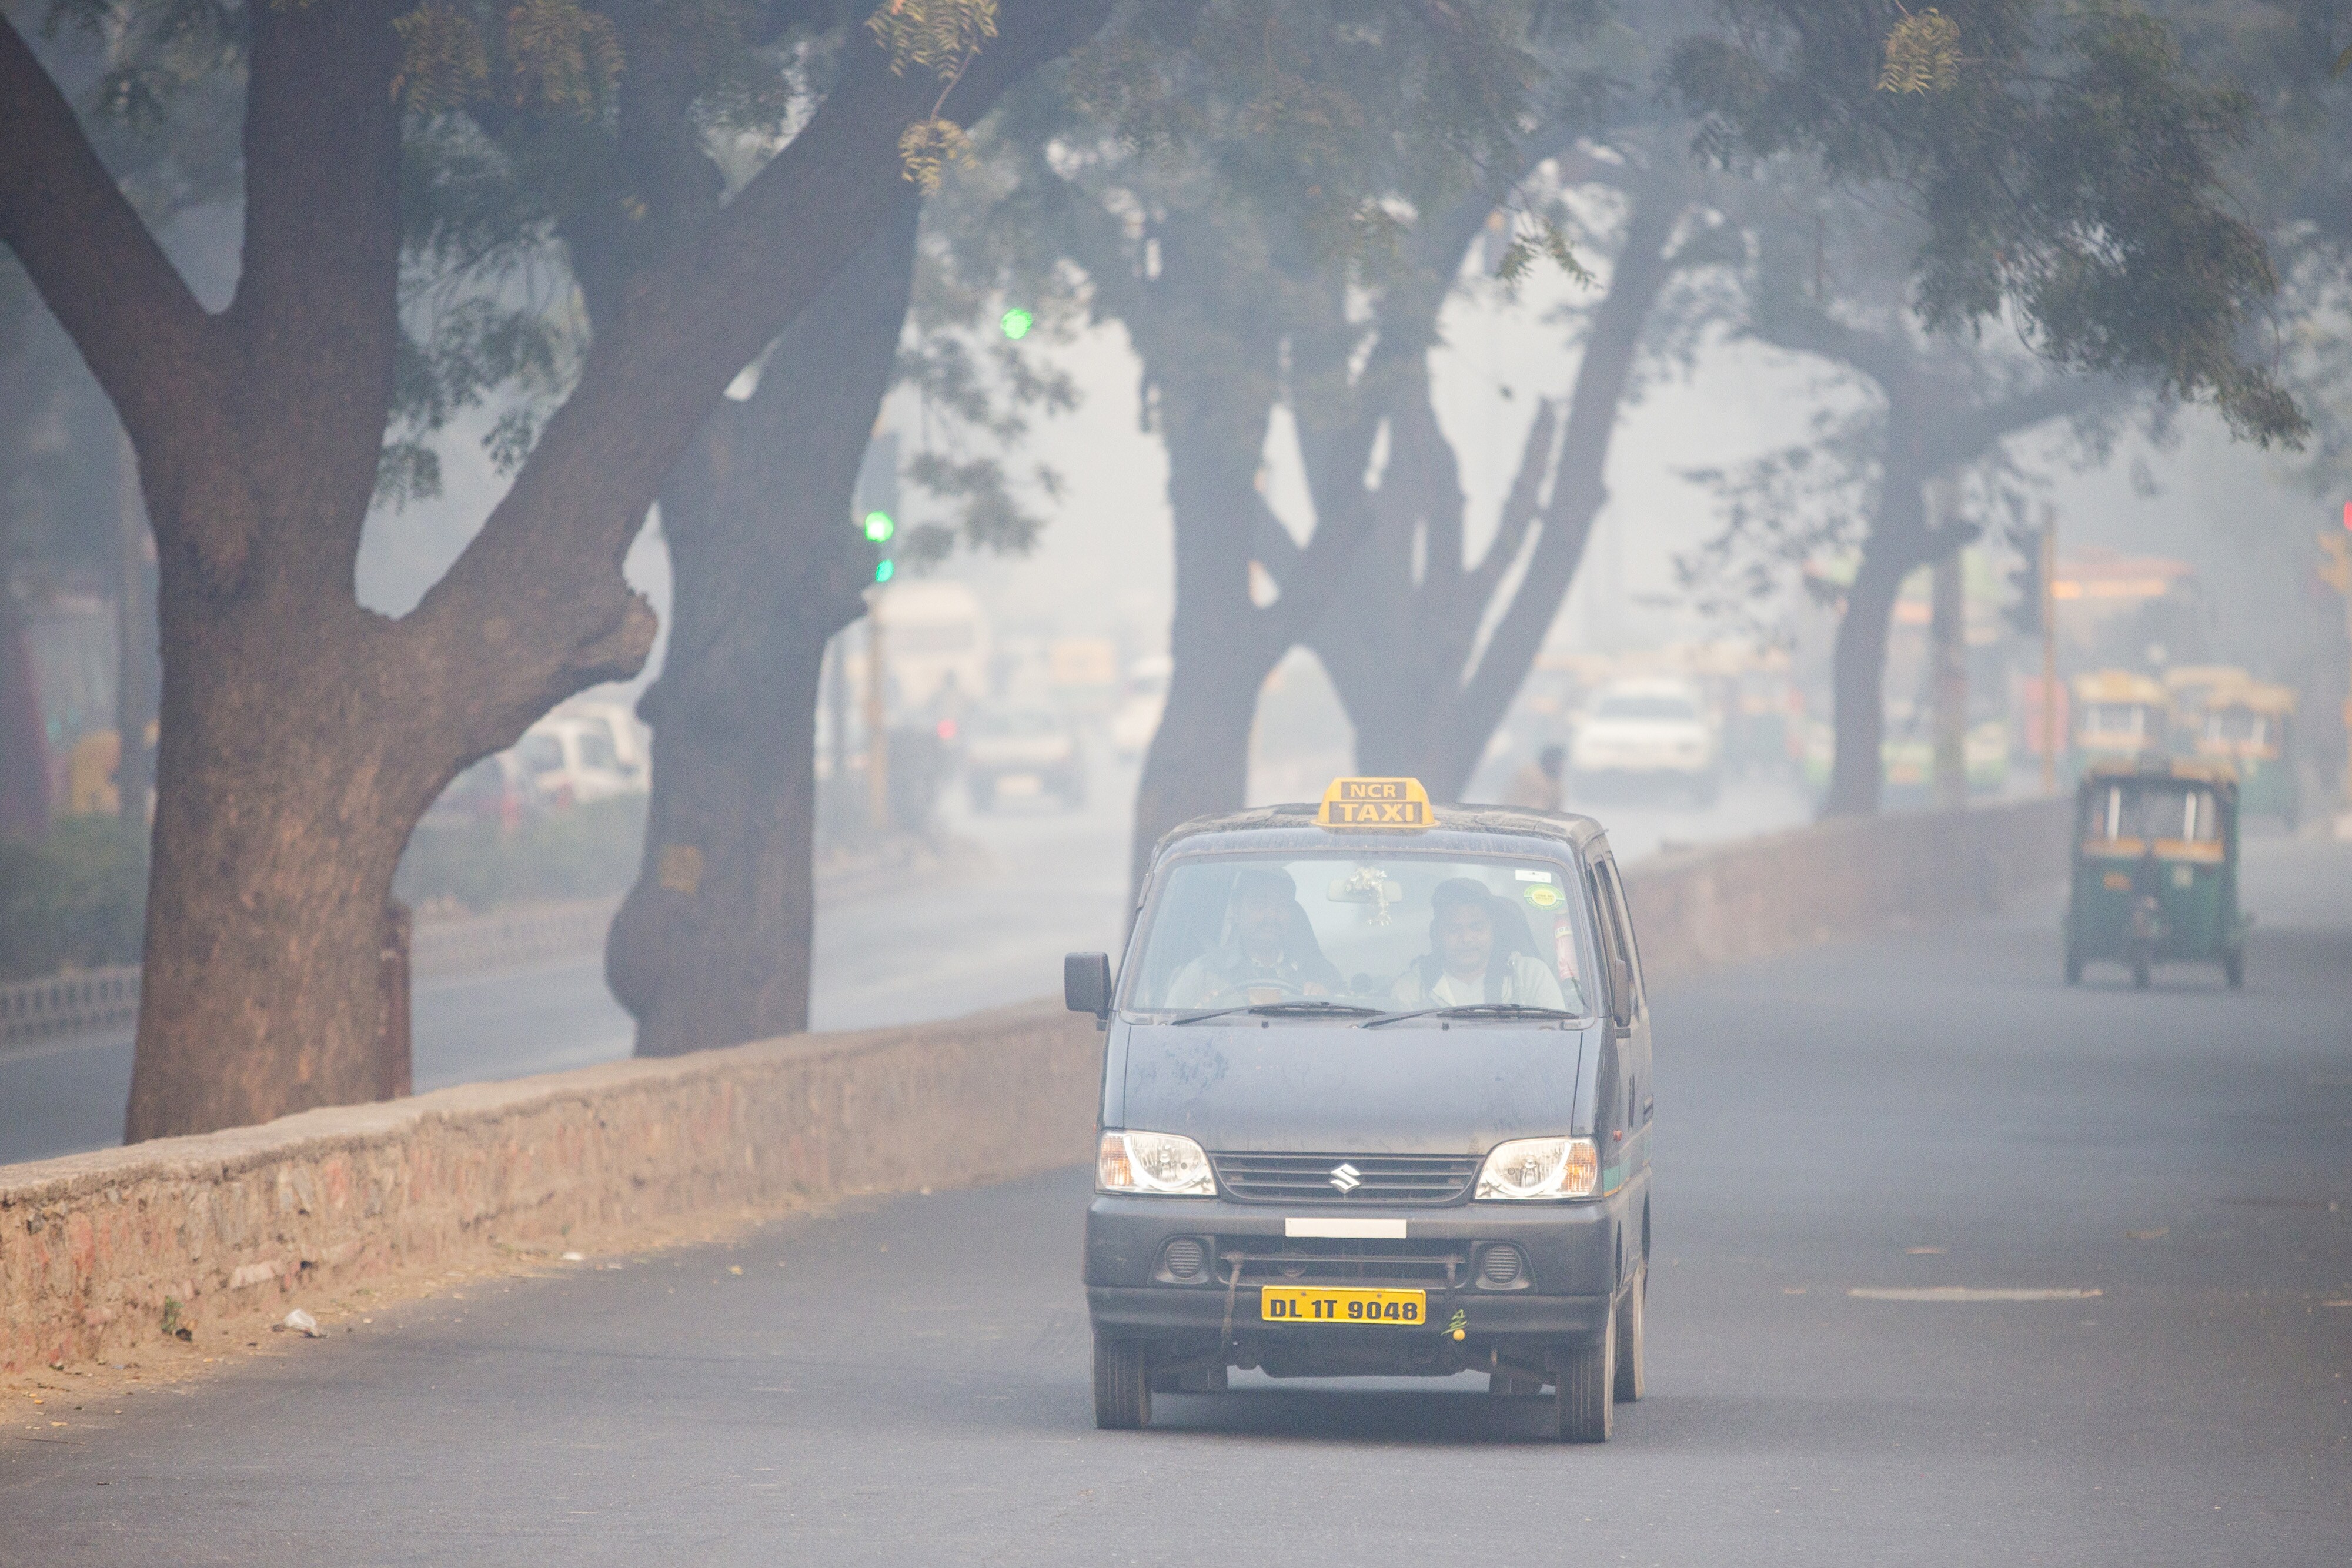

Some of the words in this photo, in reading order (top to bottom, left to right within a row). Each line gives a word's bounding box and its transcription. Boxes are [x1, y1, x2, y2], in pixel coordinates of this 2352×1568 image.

[1350, 784, 1396, 798] NCR
[1339, 804, 1414, 822] TAXI
[1270, 1299, 1302, 1318] DL
[1311, 1300, 1337, 1318] 1T
[1348, 1301, 1418, 1320] 9048
